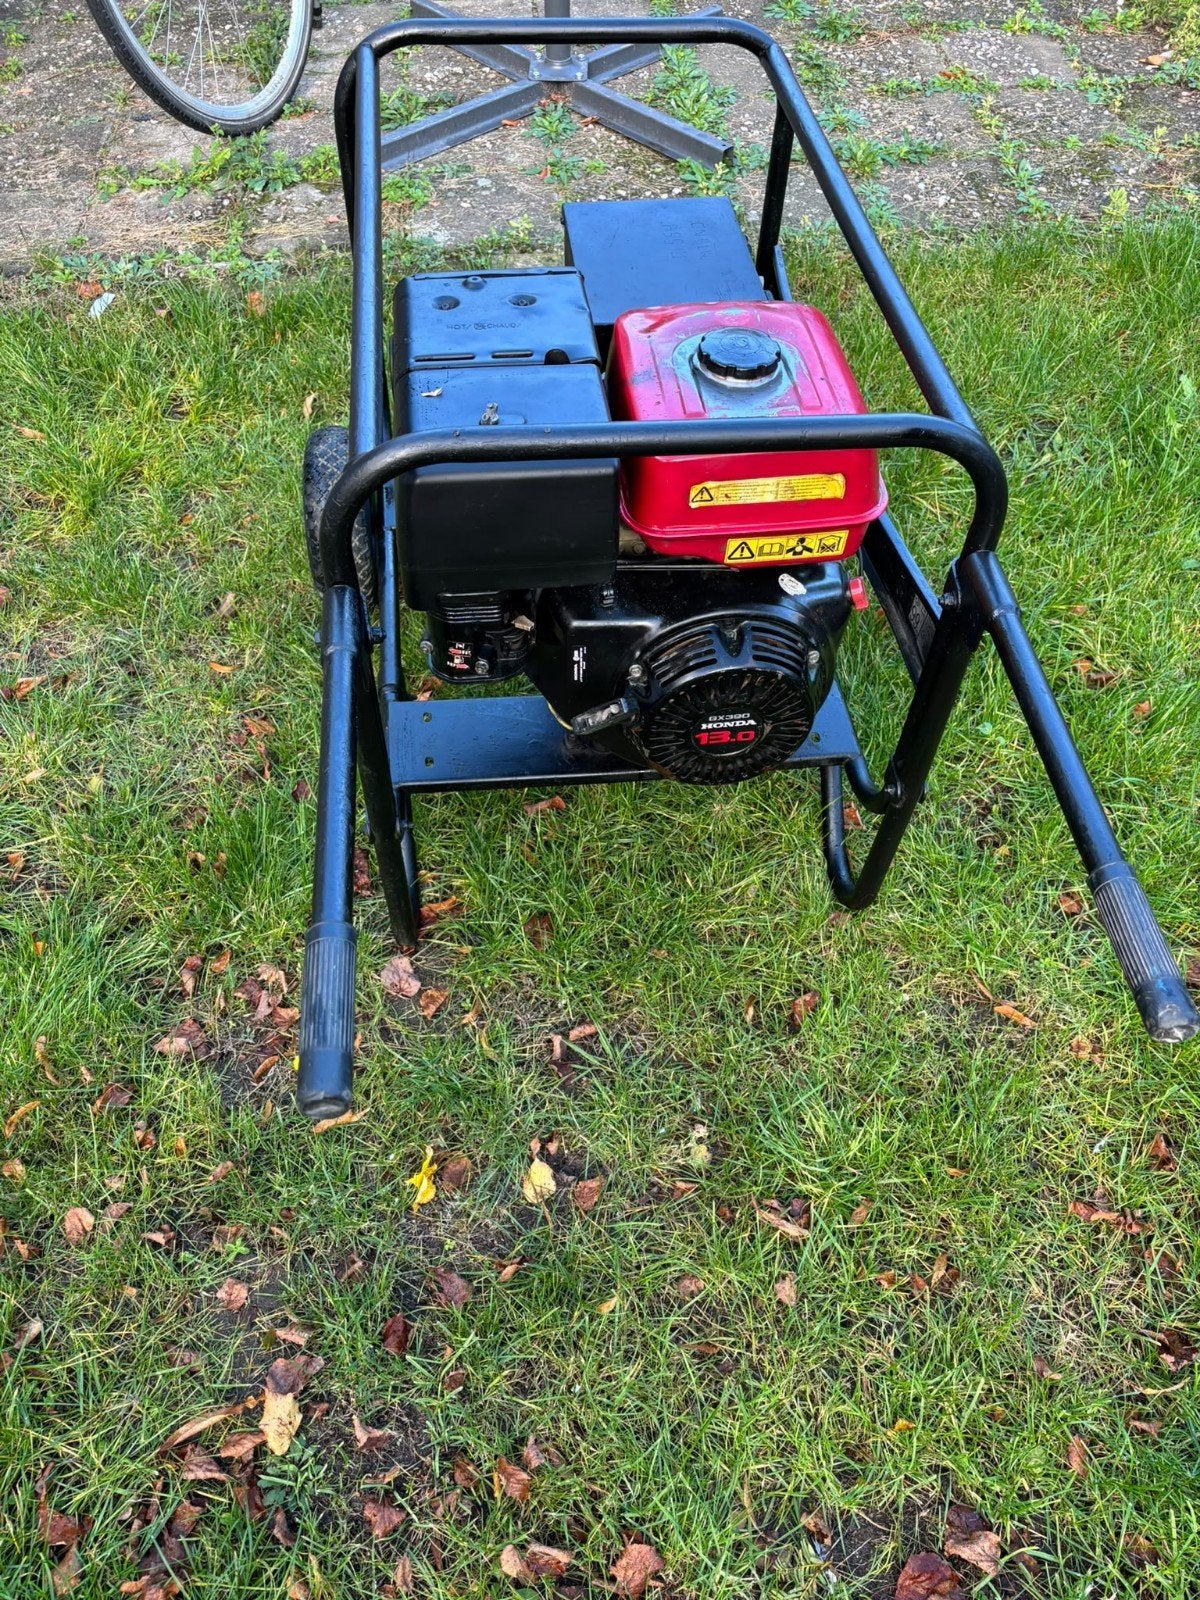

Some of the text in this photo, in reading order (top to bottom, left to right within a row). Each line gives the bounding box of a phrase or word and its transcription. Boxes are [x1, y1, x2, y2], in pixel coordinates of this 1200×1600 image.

[709, 713, 750, 721] GX390
[701, 720, 757, 729] HONDA
[695, 730, 755, 745] 13.0
